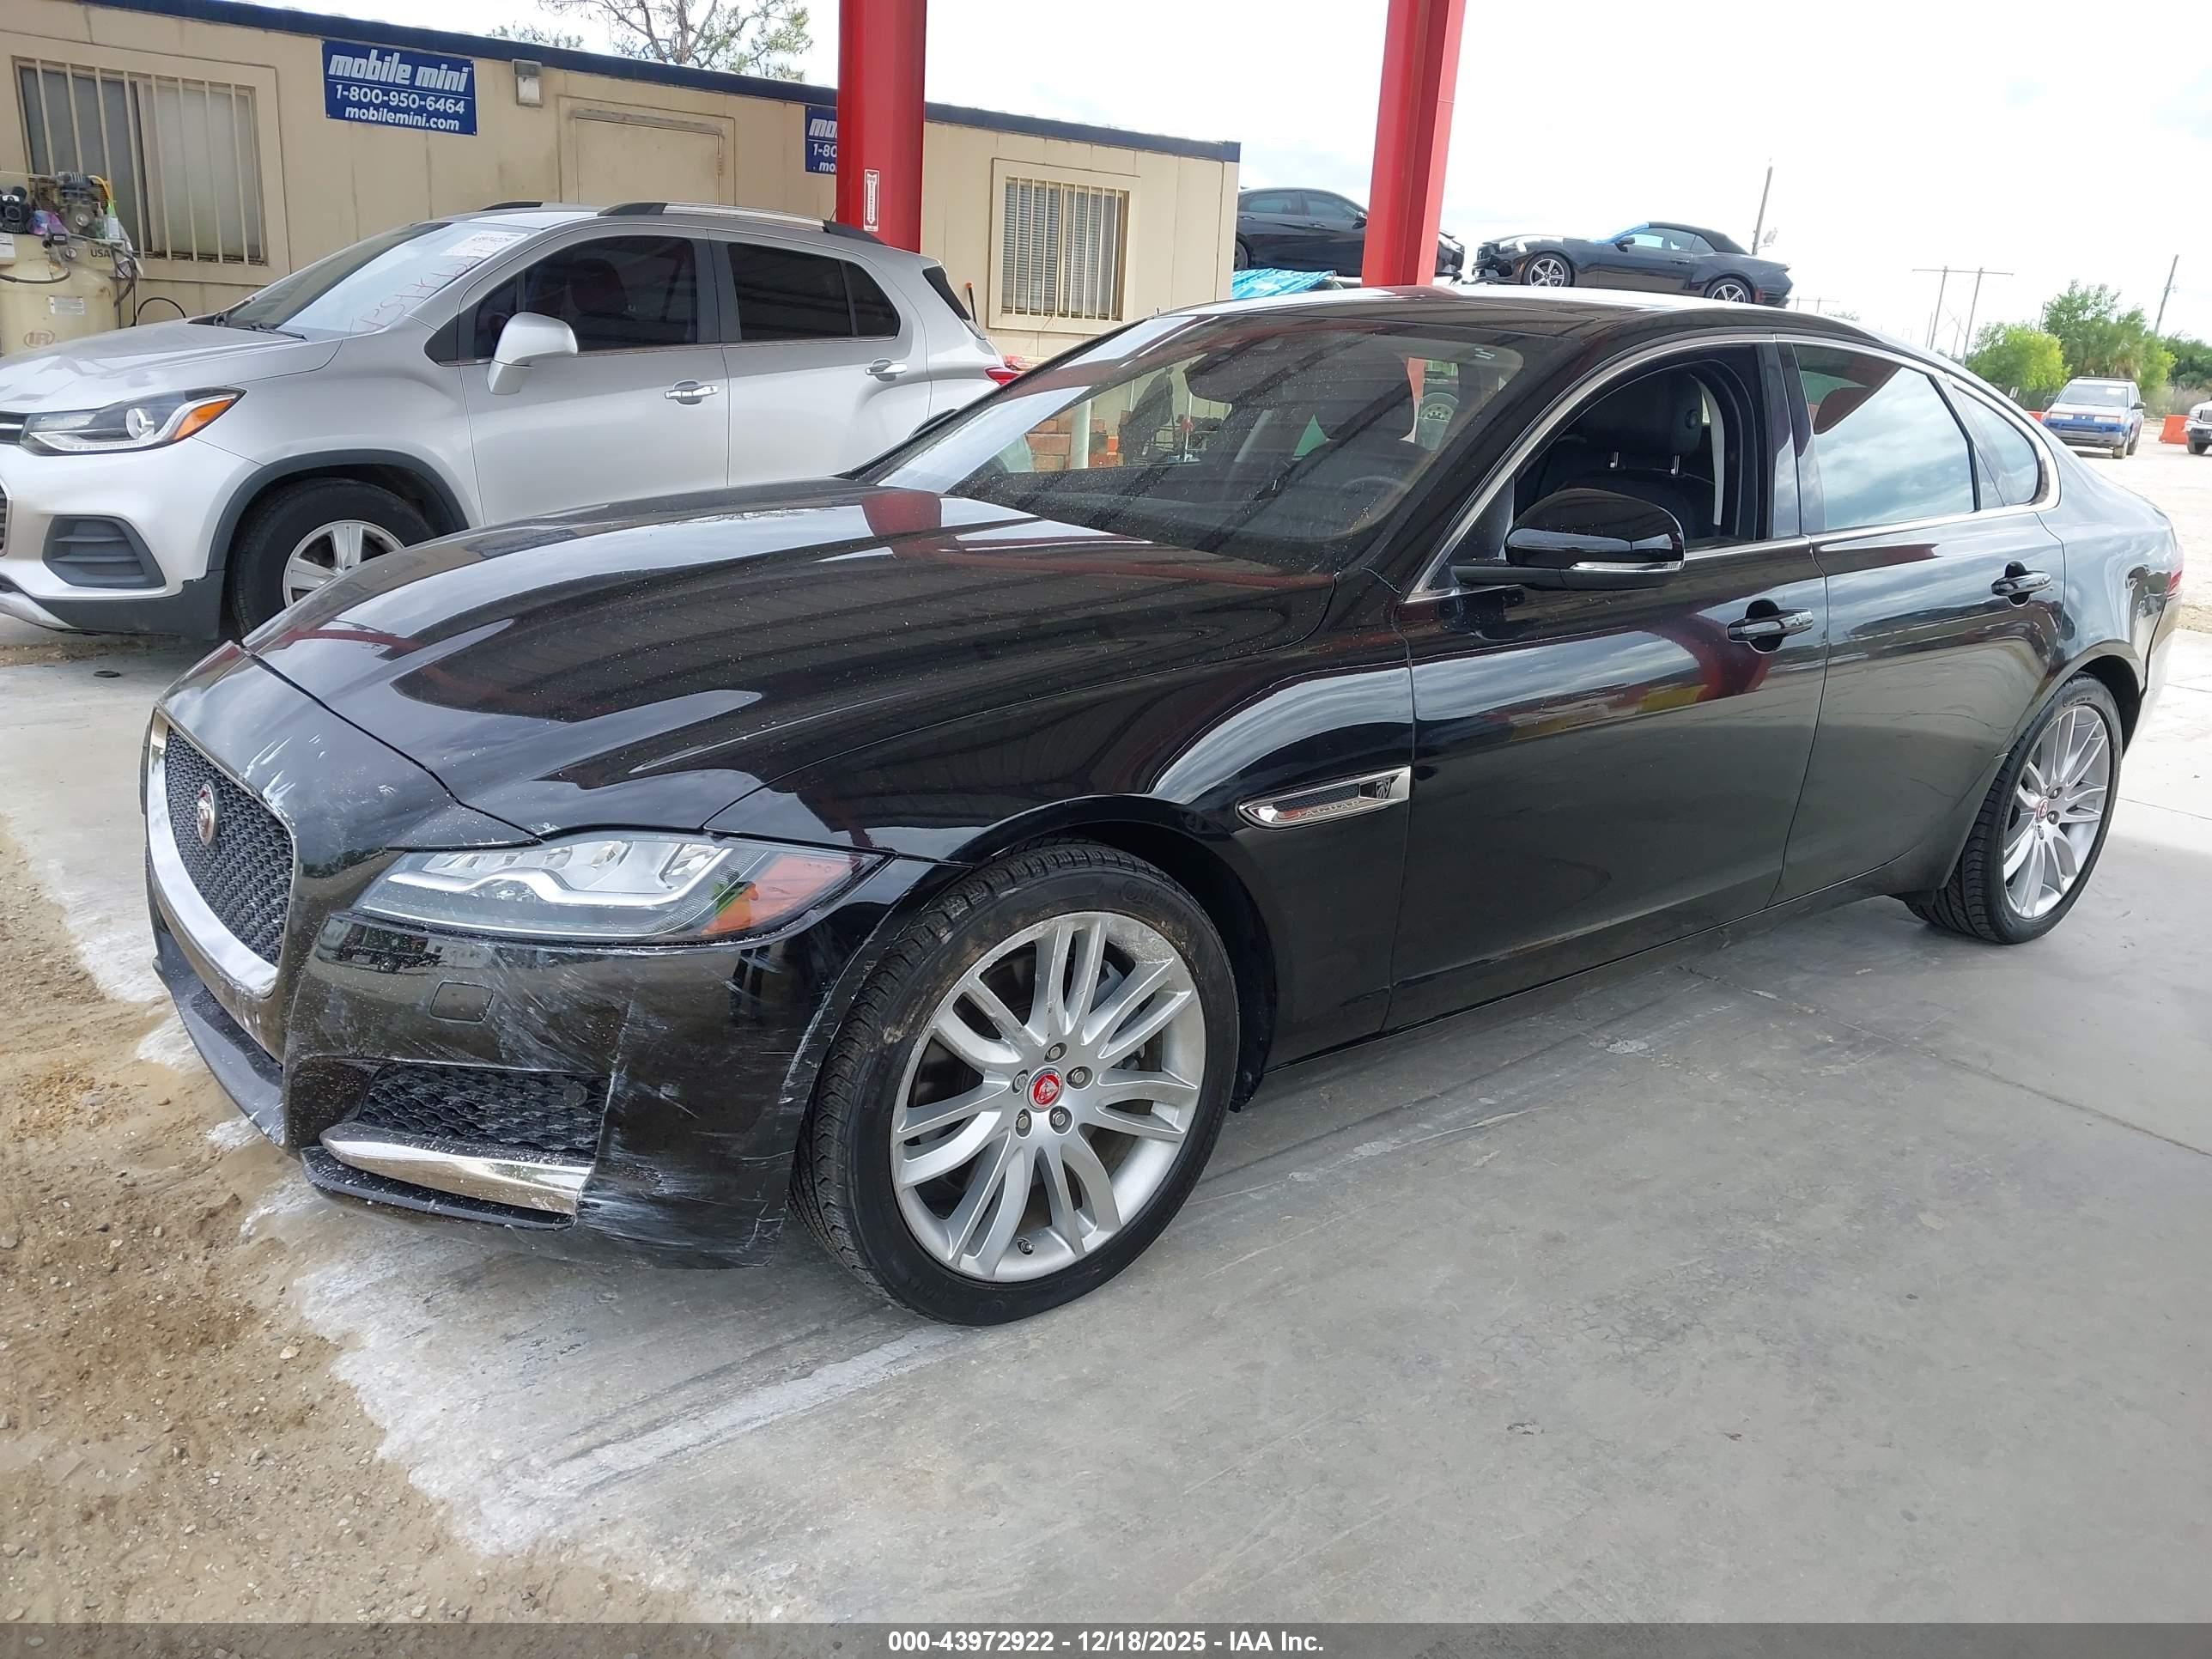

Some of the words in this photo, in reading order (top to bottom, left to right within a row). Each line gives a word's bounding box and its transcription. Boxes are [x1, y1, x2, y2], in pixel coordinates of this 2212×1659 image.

[328, 48, 412, 85] mobile
[414, 64, 470, 92] mini
[336, 84, 465, 114] 1-800-950-6464
[345, 106, 460, 131] mobilemini.com
[809, 118, 837, 138] mo
[90, 248, 111, 258] USA
[1297, 799, 1362, 818] JAGUAR
